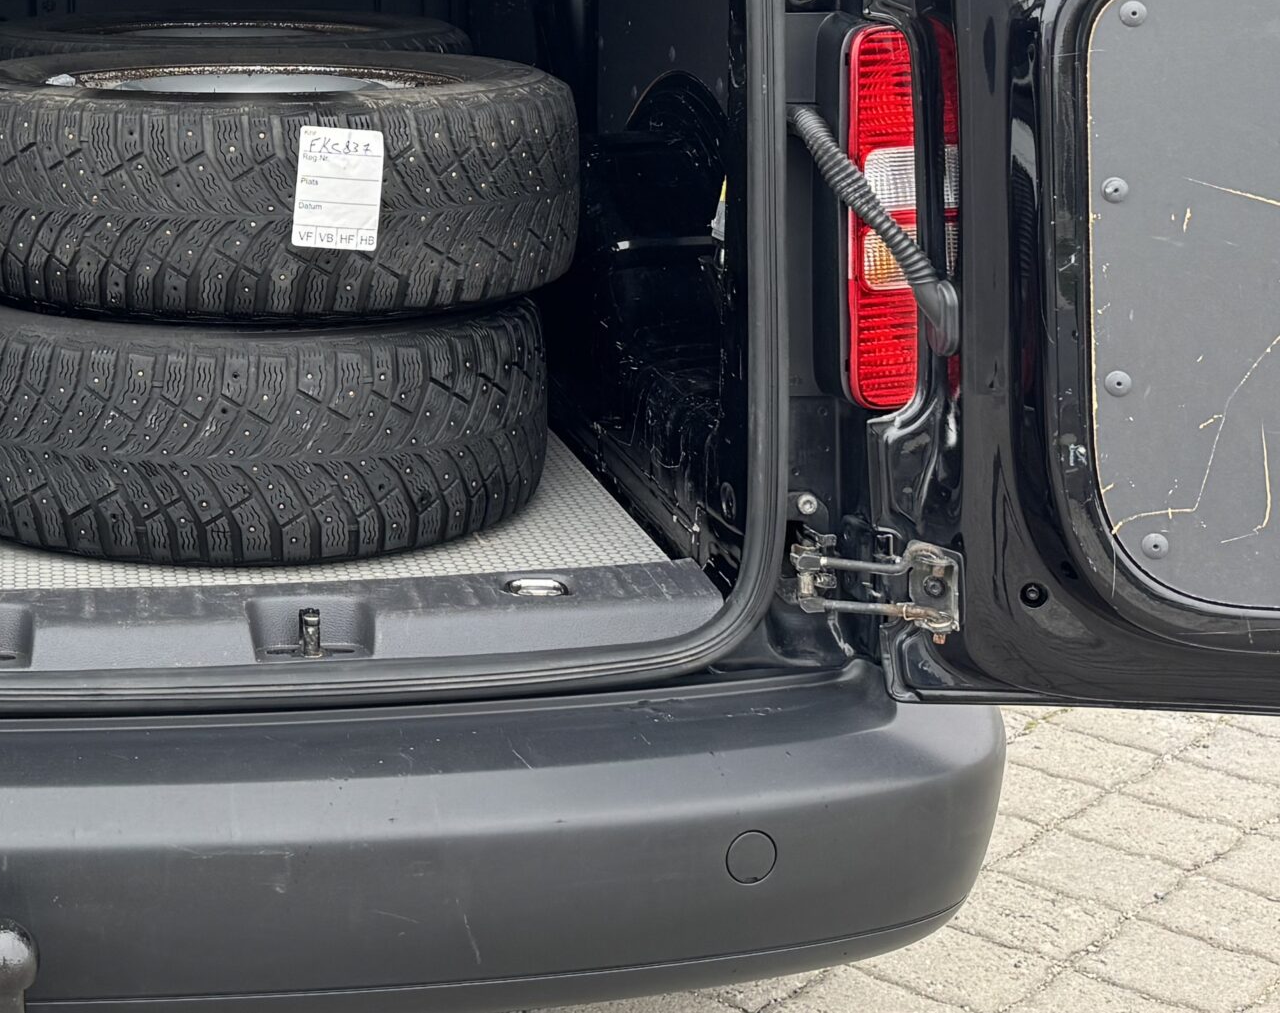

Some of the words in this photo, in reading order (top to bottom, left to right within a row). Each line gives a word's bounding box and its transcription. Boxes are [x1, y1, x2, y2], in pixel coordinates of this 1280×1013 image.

[298, 202, 322, 210] Datum
[299, 231, 313, 242] VF
[319, 233, 334, 243] VB
[340, 234, 355, 244] HF
[360, 236, 375, 246] HB
